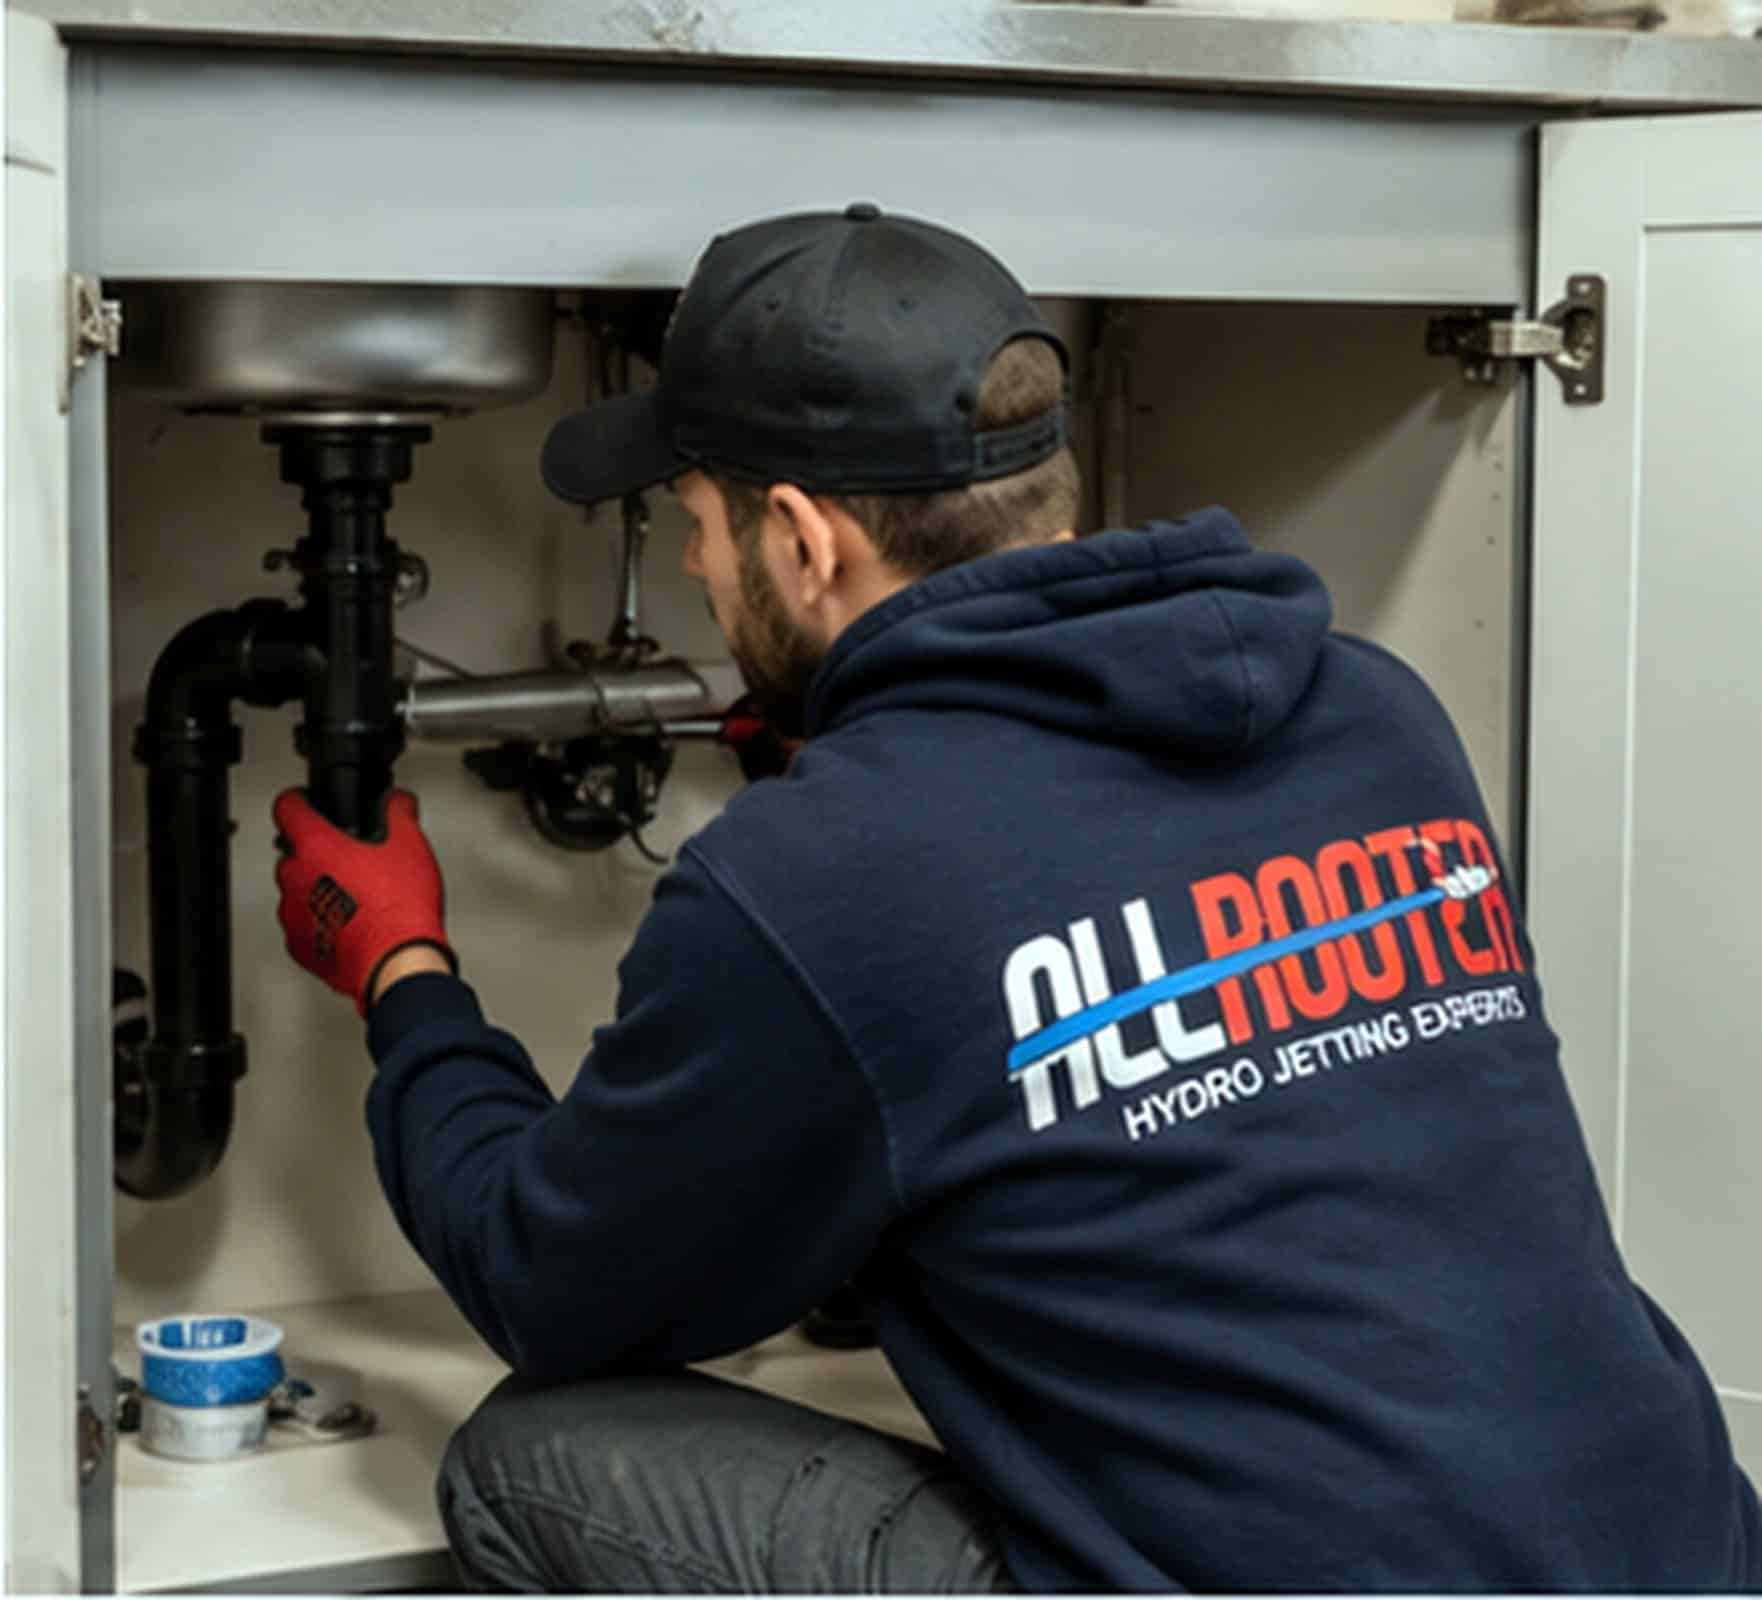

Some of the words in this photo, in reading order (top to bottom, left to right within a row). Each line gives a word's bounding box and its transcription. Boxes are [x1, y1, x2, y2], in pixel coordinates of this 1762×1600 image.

[1003, 898, 1227, 1132] ALL
[1190, 819, 1524, 1044] ROOTER
[1122, 1060, 1263, 1141] HYDRO
[1273, 1011, 1409, 1085] JETTING
